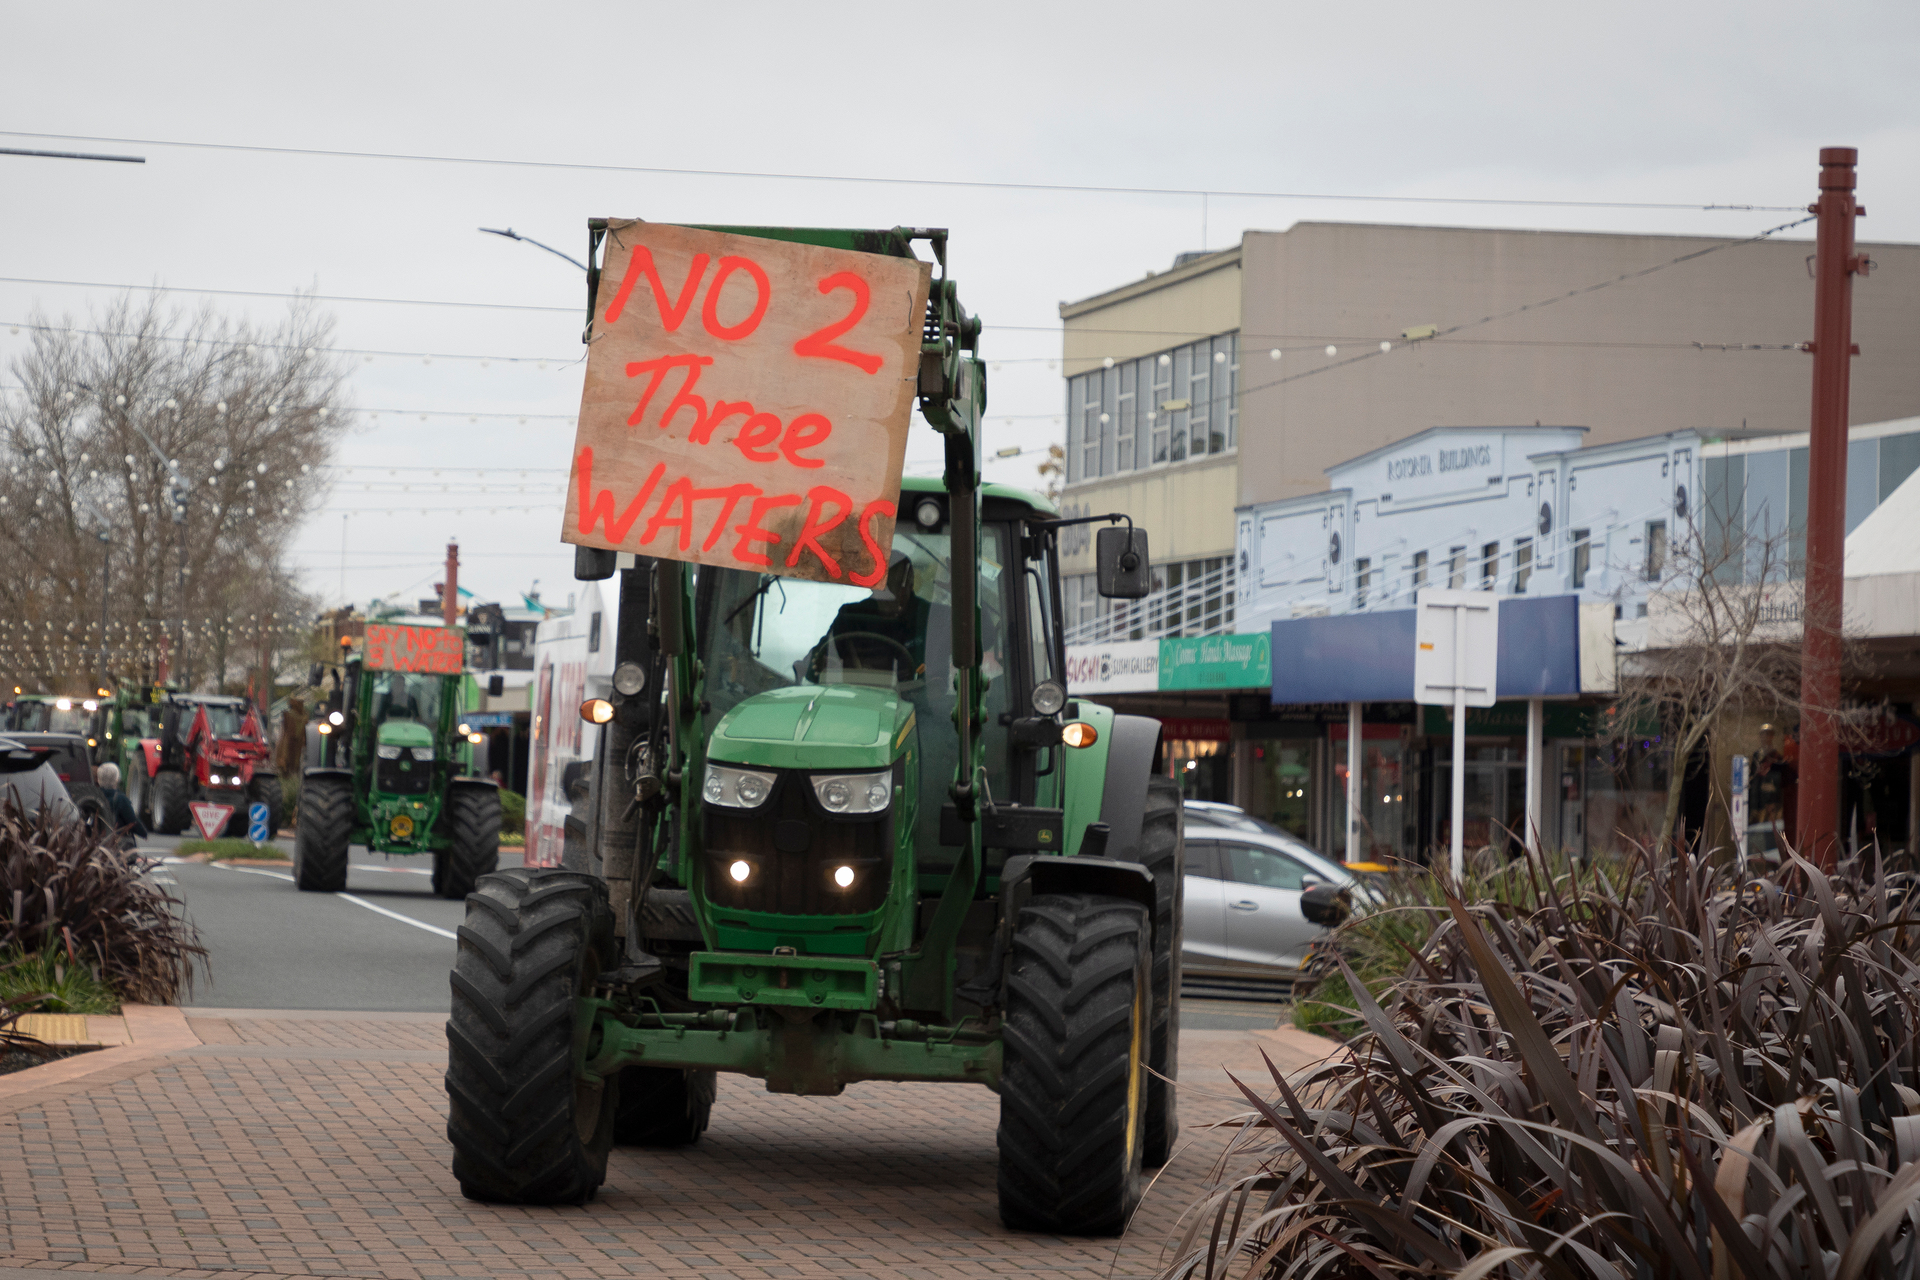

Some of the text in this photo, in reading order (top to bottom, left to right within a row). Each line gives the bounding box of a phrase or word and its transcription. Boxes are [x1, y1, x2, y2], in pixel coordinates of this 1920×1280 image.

[605, 244, 883, 375] NO 2
[625, 353, 832, 468] Three
[1387, 444, 1491, 481] ROTORUA BUILDINGS
[576, 446, 896, 587] WATERS
[367, 625, 405, 648] SAY
[406, 626, 438, 652] NO
[368, 646, 385, 668] 3
[1067, 654, 1100, 684] SUSHI
[1130, 655, 1159, 674] GALLERY
[202, 811, 220, 819] GIVE
